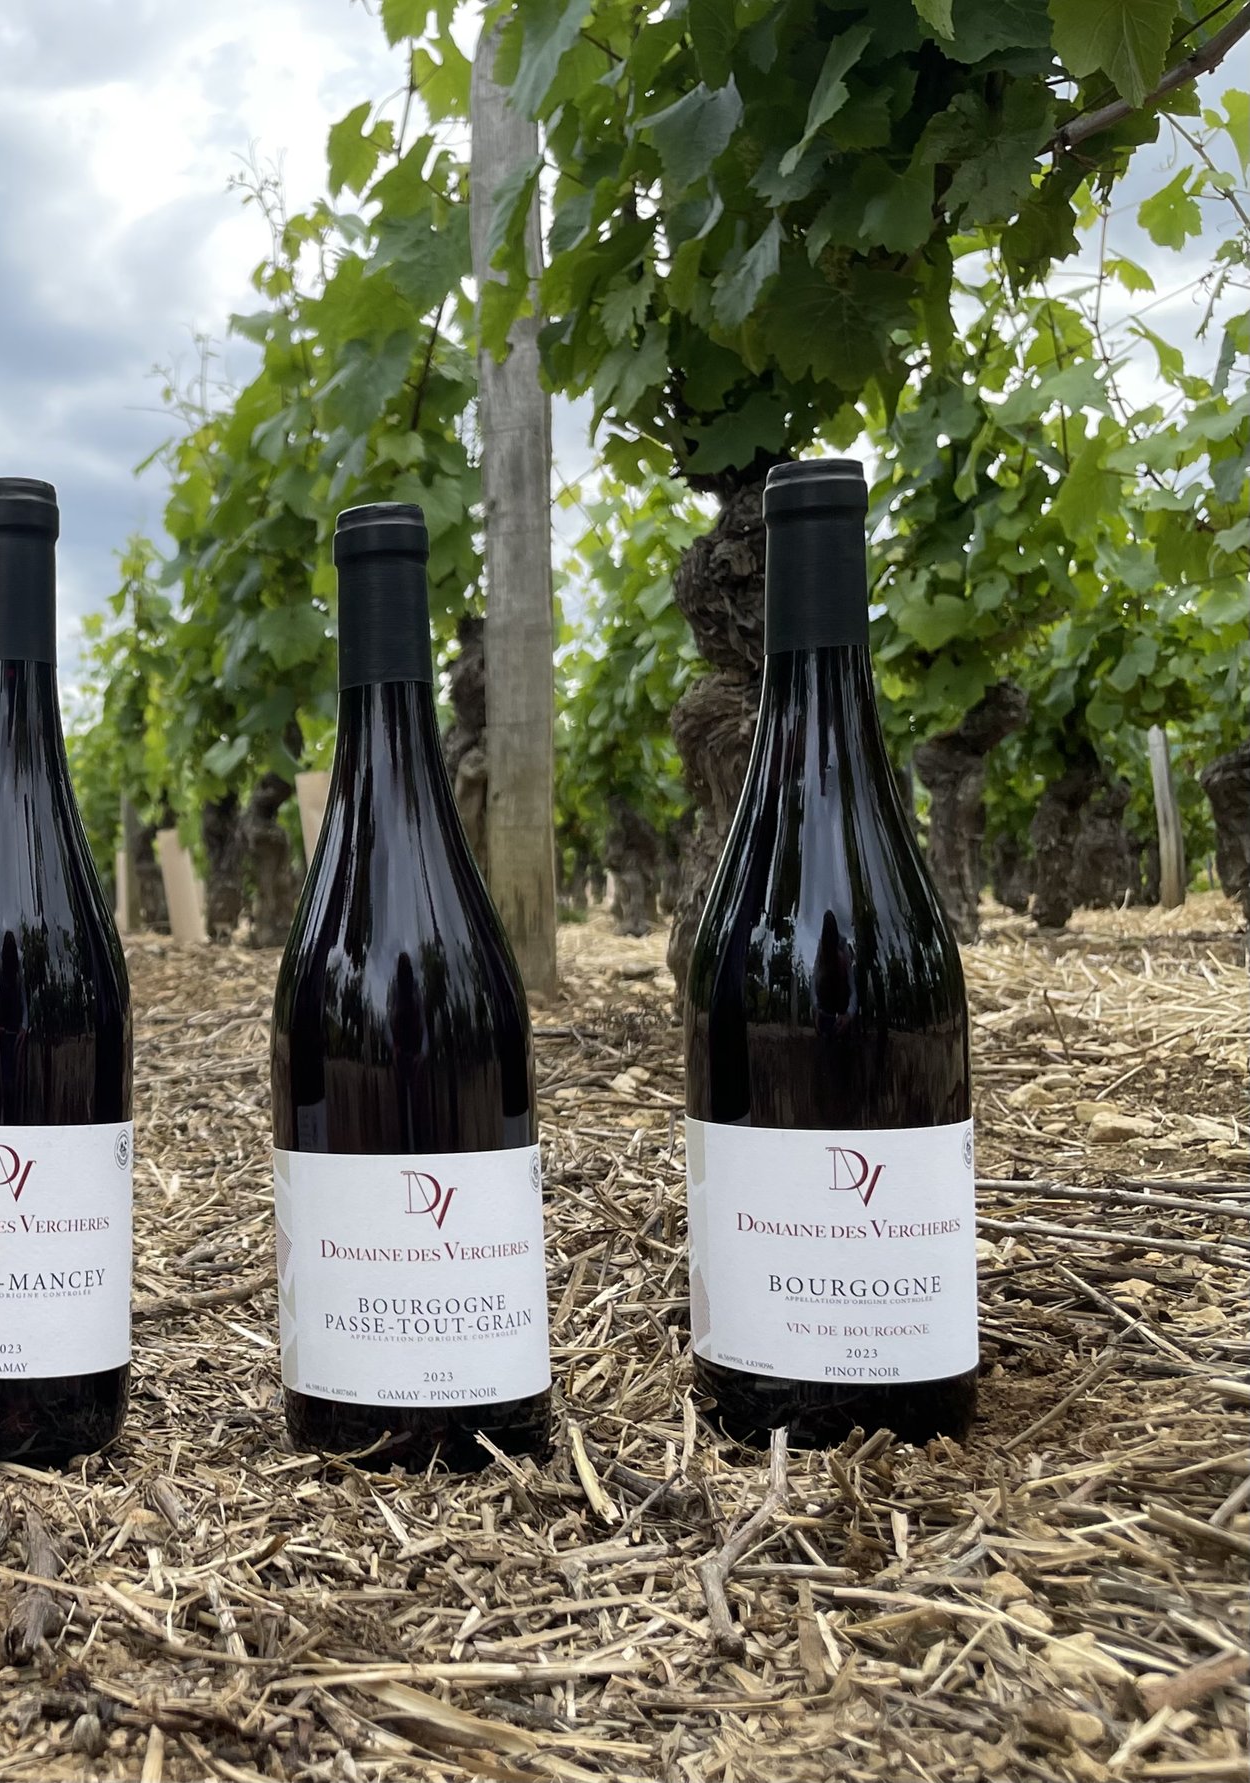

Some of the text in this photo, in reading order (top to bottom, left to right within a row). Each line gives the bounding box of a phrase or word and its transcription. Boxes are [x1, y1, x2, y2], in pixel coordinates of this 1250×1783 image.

[768, 1274, 942, 1298] BOURGOGNE
[358, 1294, 507, 1315] BOURGOGNE
[785, 1296, 841, 1305] APPELLATION
[325, 1308, 533, 1335] PASSE-TOUT-GRAIN
[787, 1322, 930, 1337] VIN DE BOURGOGNE
[350, 1334, 414, 1342] APPELLATION
[845, 1348, 878, 1359] 2023
[423, 1372, 454, 1382] 2023
[824, 1366, 900, 1377] PINOT NOIR
[377, 1389, 420, 1401] GAMAY
[430, 1389, 466, 1400] PINOT
[469, 1387, 497, 1398] NOIR
